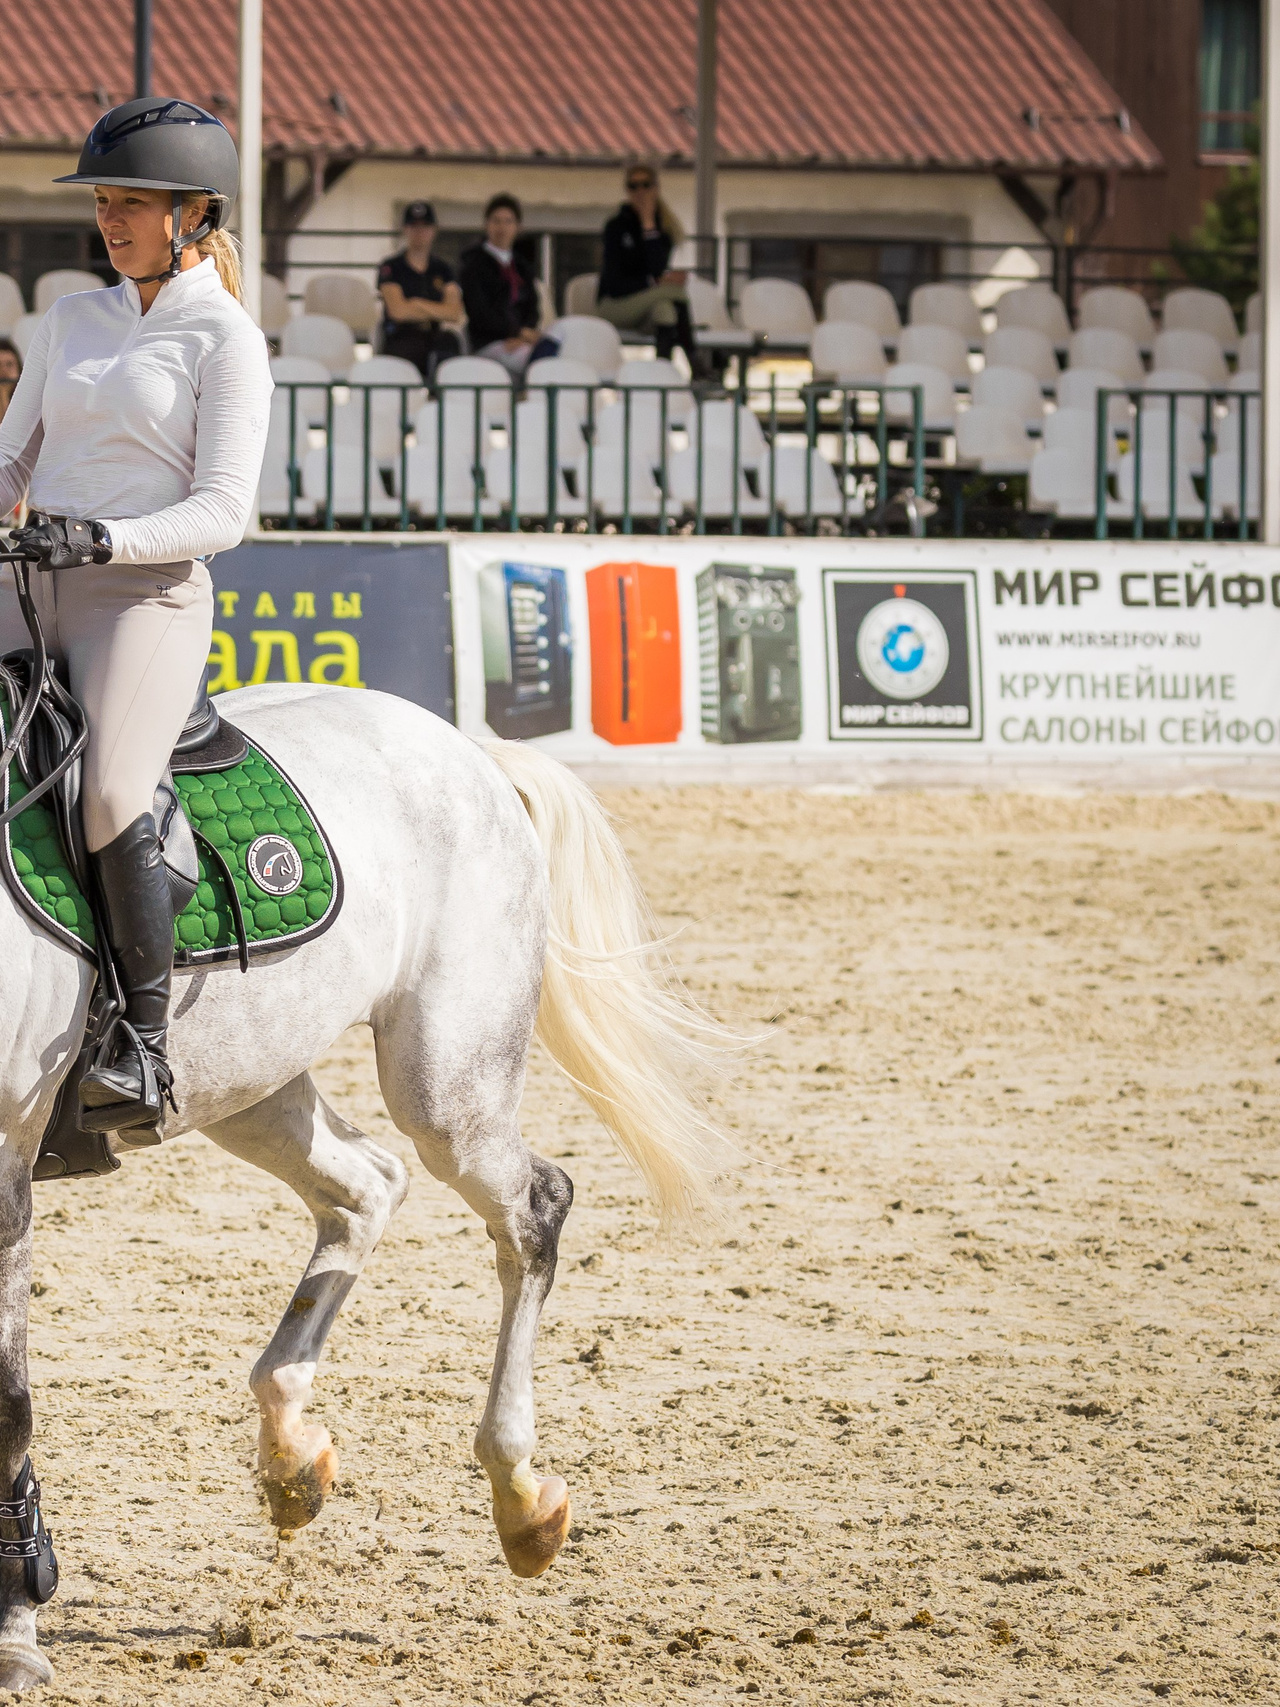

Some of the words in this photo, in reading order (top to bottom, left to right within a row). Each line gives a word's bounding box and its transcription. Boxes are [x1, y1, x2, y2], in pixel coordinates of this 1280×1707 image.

[993, 569, 1100, 607] МИР
[1120, 562, 1280, 609] СЕЙФ
[217, 591, 363, 618] ТАЛЫ
[999, 664, 1237, 701] КРУПНЕЙШИЕ
[999, 716, 1147, 744] САЛОНЫ
[1159, 709, 1280, 745] СЕЙФО
